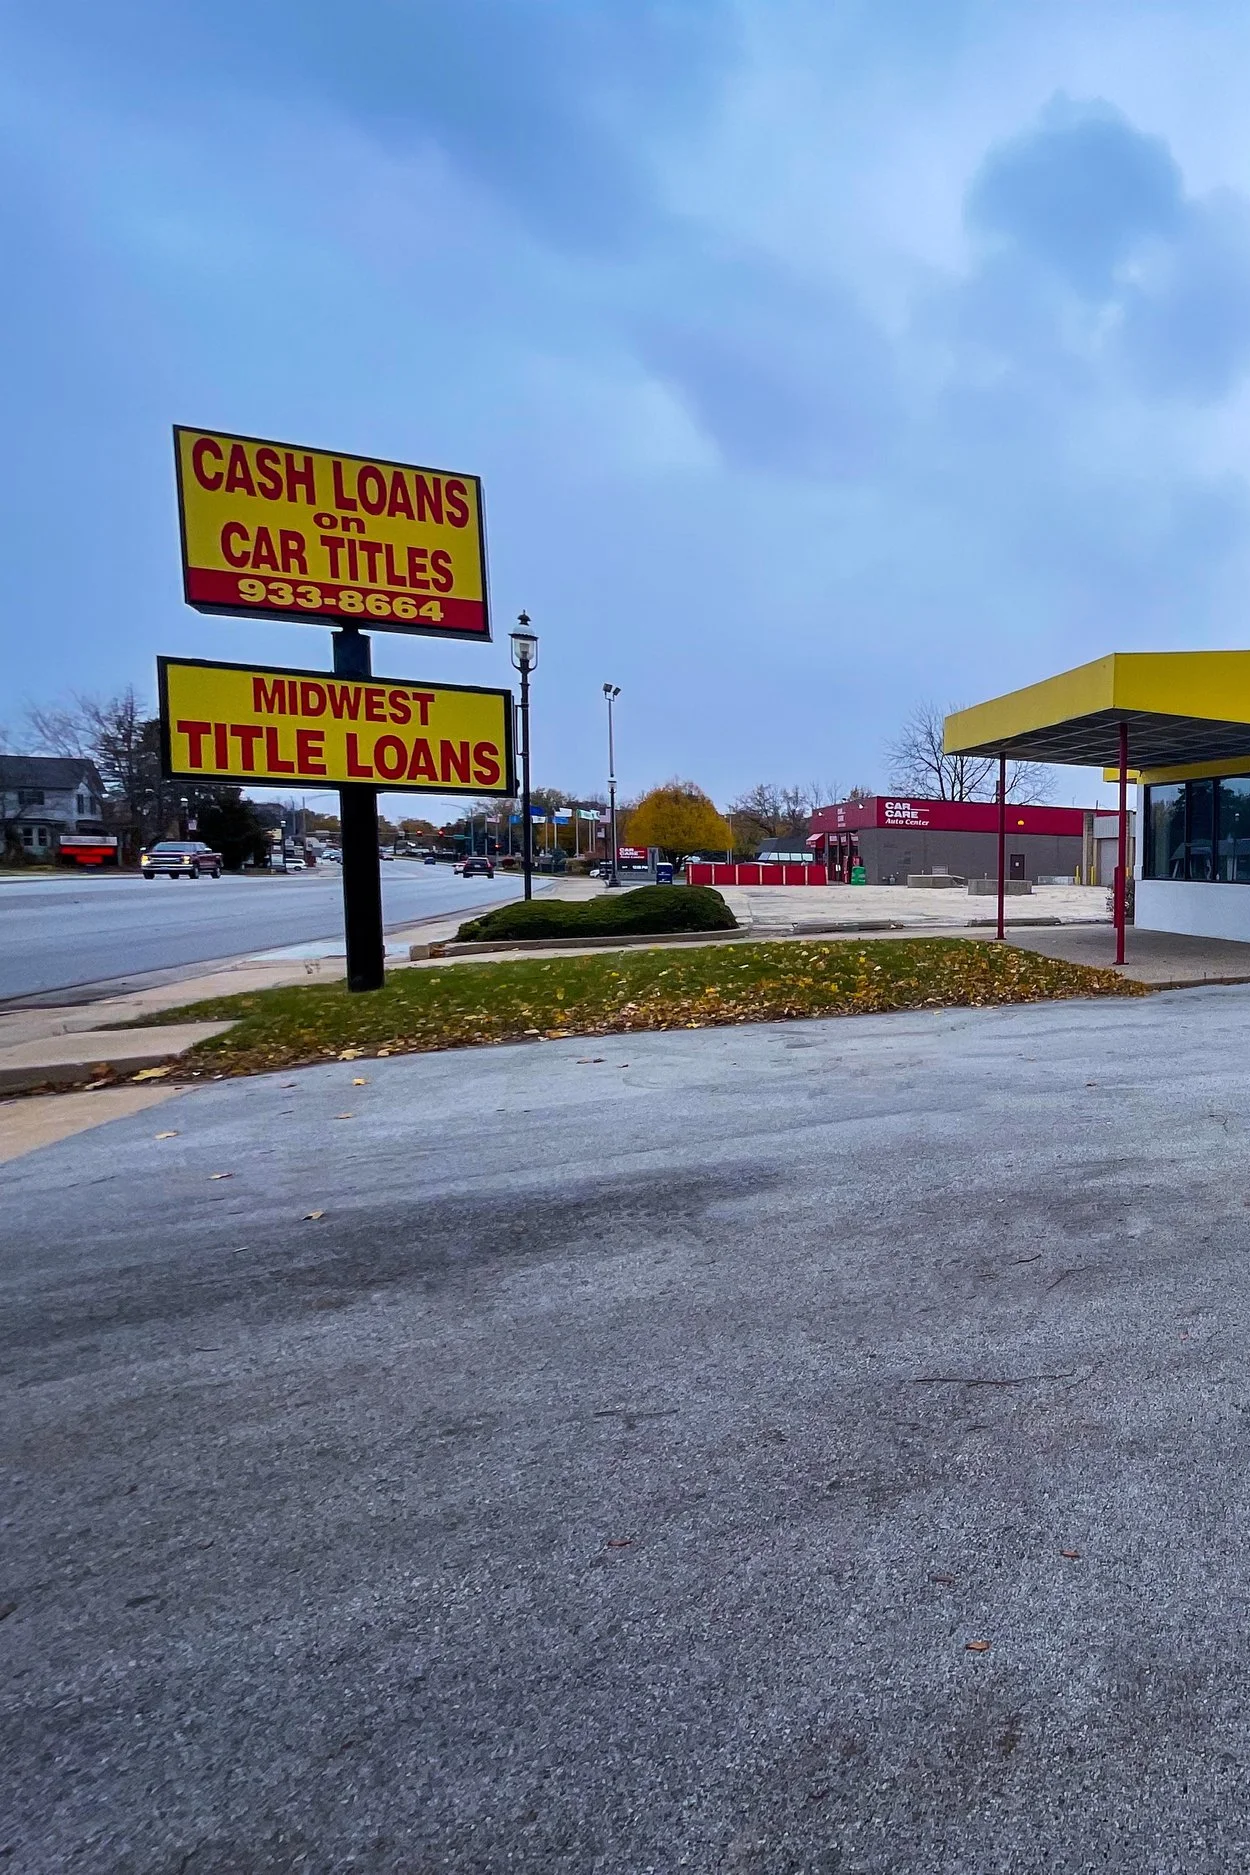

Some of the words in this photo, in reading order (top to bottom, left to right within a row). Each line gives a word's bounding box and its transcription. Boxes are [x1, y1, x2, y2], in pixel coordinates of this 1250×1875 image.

[192, 437, 316, 506] CASH
[332, 460, 470, 528] LOANS
[312, 511, 366, 534] on
[220, 521, 308, 575] CAR
[320, 535, 454, 593] TITLES
[237, 578, 444, 622] 933-8664
[252, 677, 435, 726] MIDWEST
[177, 720, 327, 776] TITLE
[345, 732, 500, 785] LOANS
[885, 802, 911, 810] CAR
[885, 810, 919, 819] CARE
